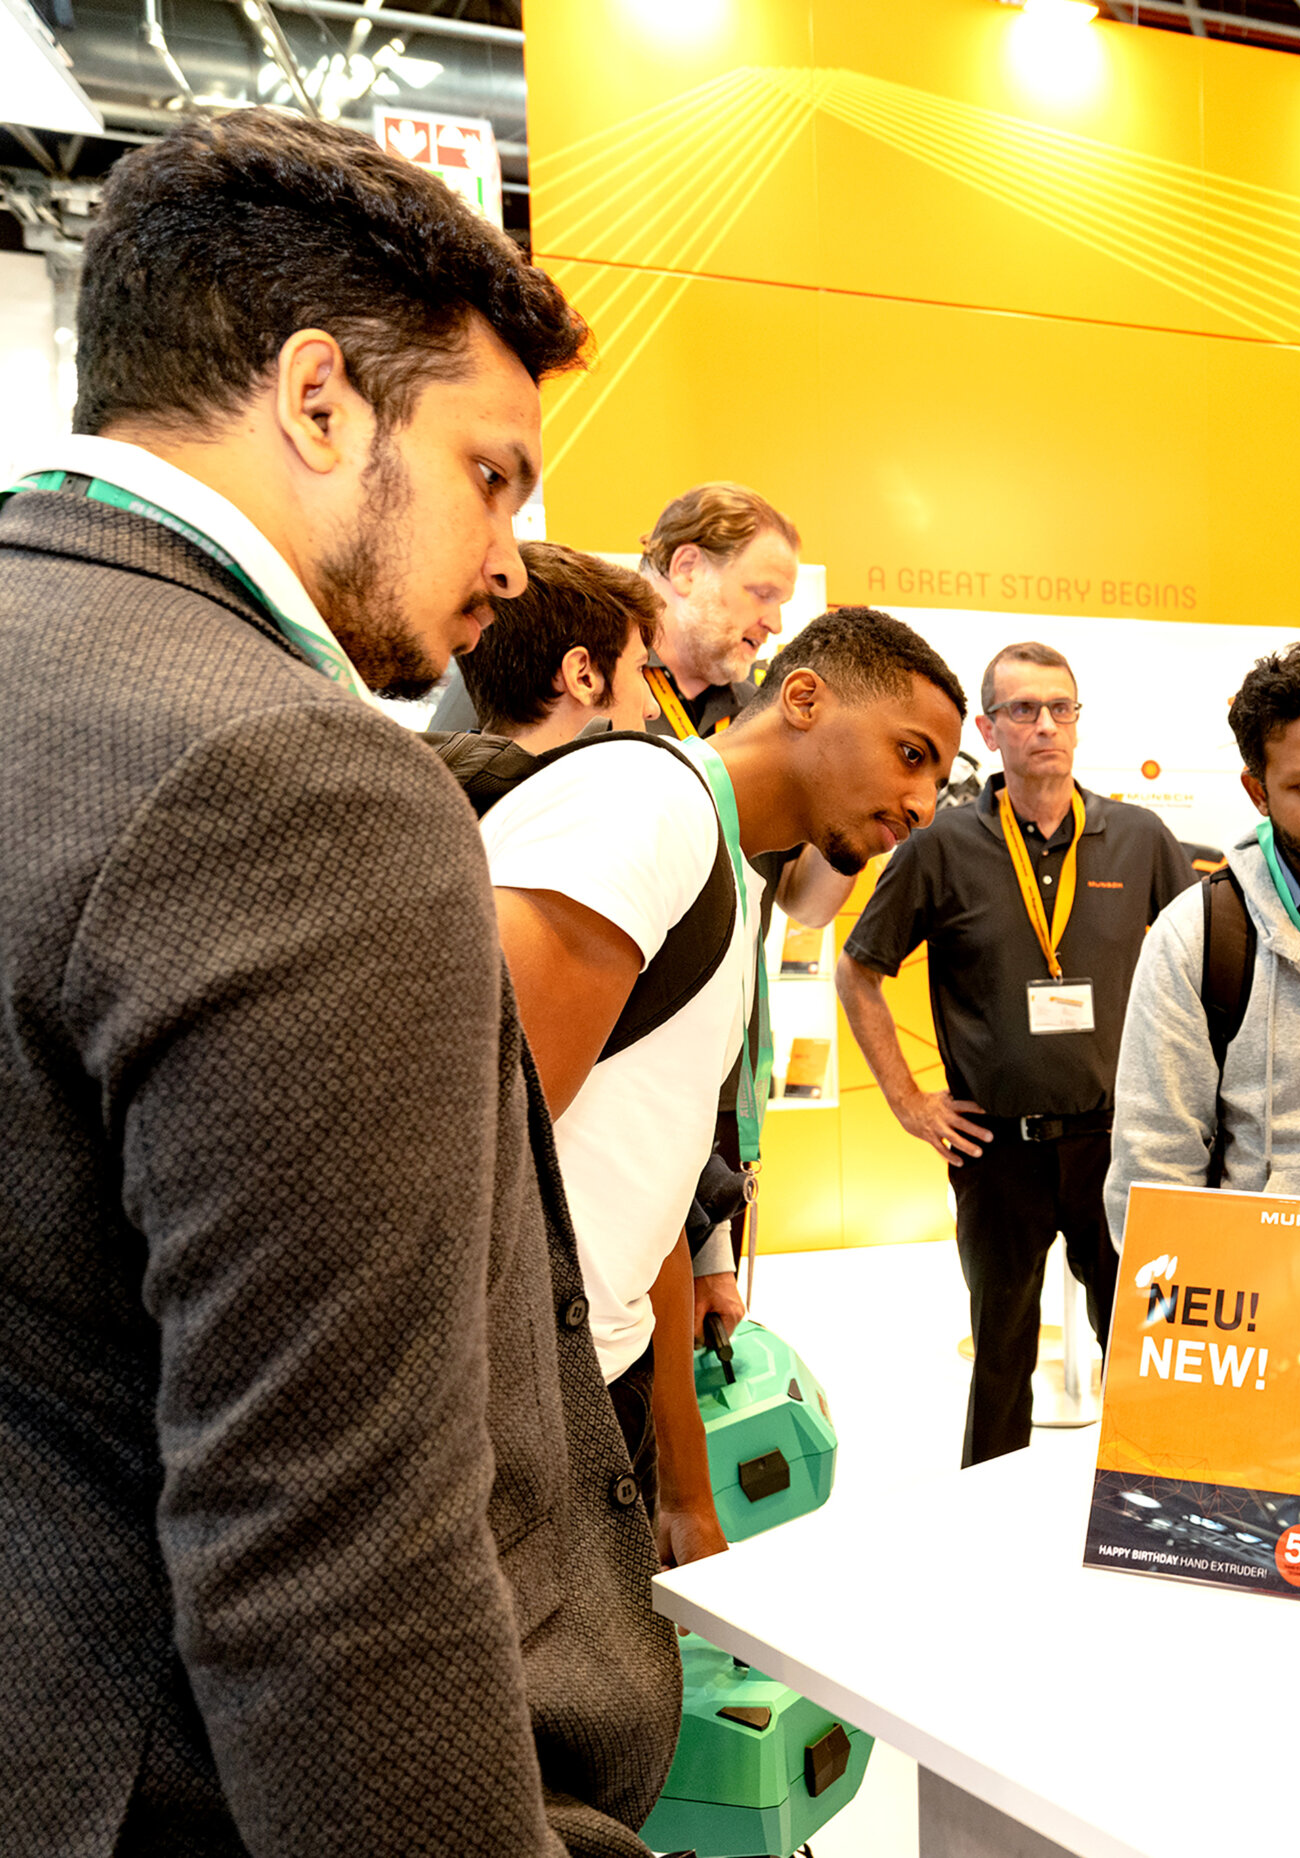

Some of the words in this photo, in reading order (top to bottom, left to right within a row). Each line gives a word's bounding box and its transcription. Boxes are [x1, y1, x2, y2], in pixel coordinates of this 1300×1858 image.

[867, 566, 886, 592] A
[897, 567, 991, 598] GREAT
[1000, 573, 1091, 604] STORY
[1101, 580, 1197, 610] BEGINS
[1146, 1282, 1260, 1332] NEU!
[1139, 1336, 1269, 1391] NEW!
[1099, 1544, 1131, 1560] HAPPY
[1131, 1549, 1180, 1567] BIRTHDAY
[1180, 1558, 1209, 1571] HAND
[1210, 1561, 1268, 1579] EXTRUDER!
